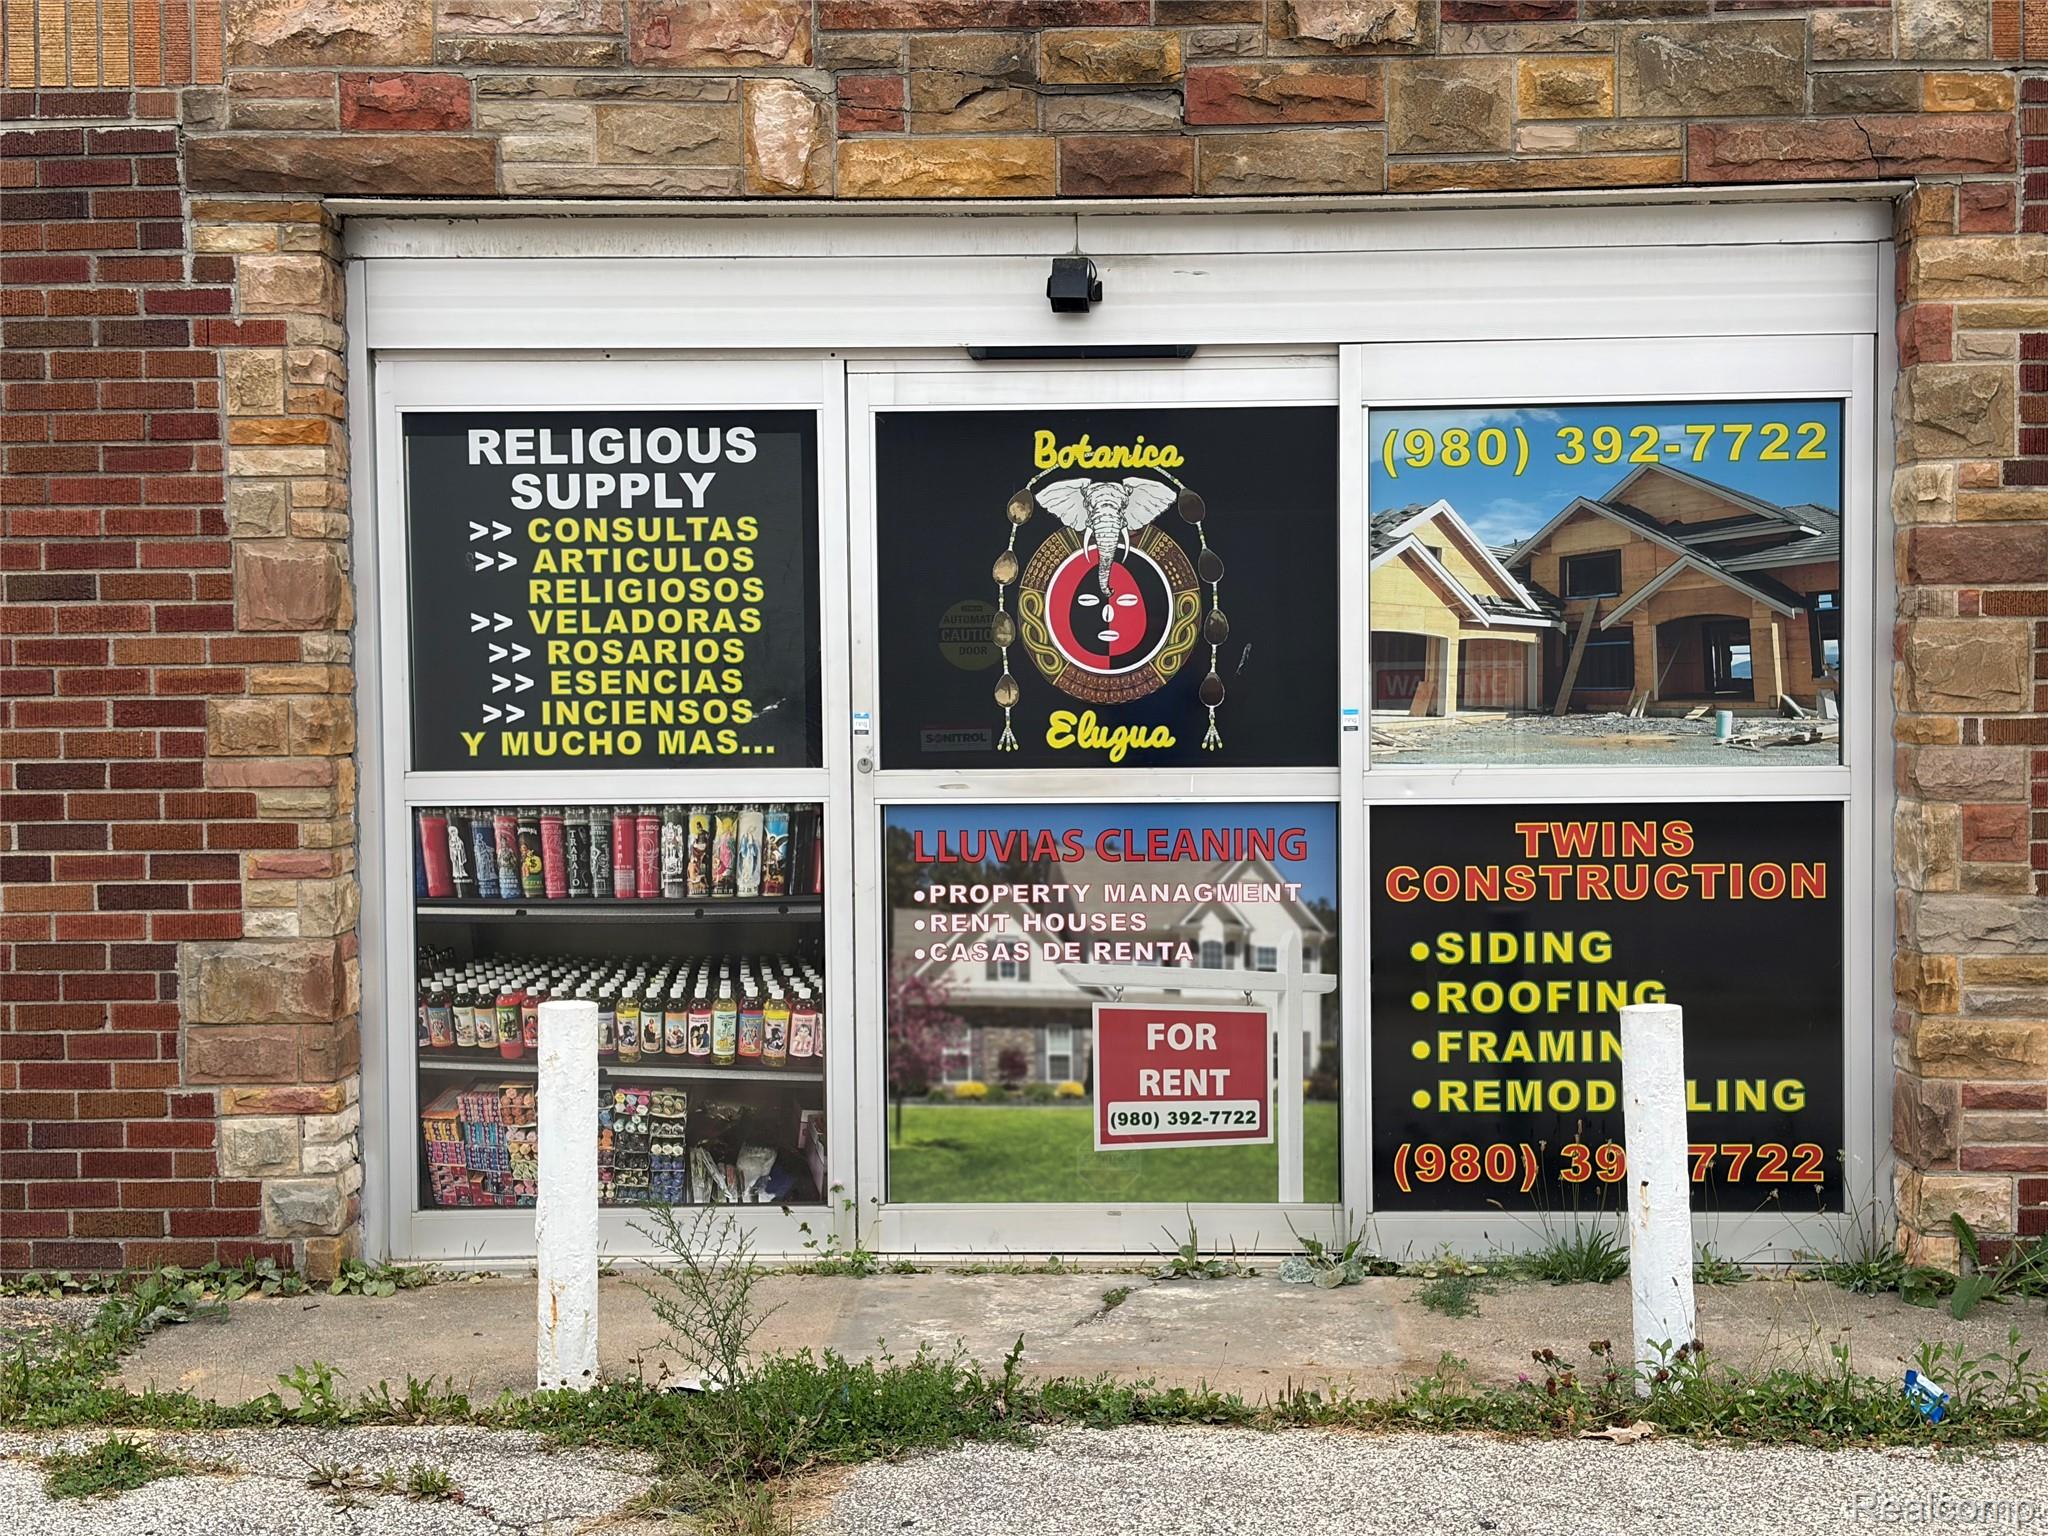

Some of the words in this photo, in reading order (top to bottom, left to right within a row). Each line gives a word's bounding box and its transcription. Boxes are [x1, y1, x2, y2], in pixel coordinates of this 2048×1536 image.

[468, 427, 757, 466] RELIGIOUS
[1034, 430, 1185, 470] Botanica
[1381, 426, 1530, 478] (980)
[1555, 421, 1828, 465] 392-7722
[510, 472, 716, 510] SUPPLY
[527, 515, 760, 543] CONSULTAS
[533, 547, 755, 573] ARTICULOS
[529, 577, 765, 605] RELIGIOSOS
[528, 608, 762, 634] VELADORAS
[942, 629, 992, 641] CAUTIO
[547, 638, 746, 664] ROSARIOS
[960, 647, 987, 655] DOOR
[550, 668, 744, 695] ESENCIAS
[541, 699, 753, 726] INCIENSOS
[461, 732, 487, 756] Y
[501, 731, 643, 756] MUCHO
[658, 730, 776, 755] MAS...
[1046, 710, 1177, 763] Elugua
[913, 828, 1085, 864] LLUVIAS
[1095, 827, 1308, 863] CLEANING
[1515, 820, 1695, 858] TWINS
[929, 883, 1091, 905] PROPERTY
[1104, 882, 1303, 903] MANAGMENT
[1385, 862, 1827, 903] CONSTRUCTION
[929, 913, 1010, 933] RENT
[1023, 912, 1147, 933] HOUSES
[928, 942, 1030, 962] CASAS
[1043, 942, 1081, 962] DE
[1093, 941, 1194, 962] RENTA
[1434, 930, 1614, 965] SIDING
[1436, 980, 1668, 1015] ROOFING
[1146, 1023, 1217, 1051] FOR
[1436, 1029, 1623, 1064] FRAMIN
[1138, 1068, 1231, 1096] RENT
[1438, 1078, 1807, 1113] REMODLING
[1110, 1111, 1160, 1131] (980)
[1167, 1109, 1257, 1126] 392-7722
[1394, 1143, 1538, 1192] (980)
[1560, 1143, 1825, 1183] 397722
